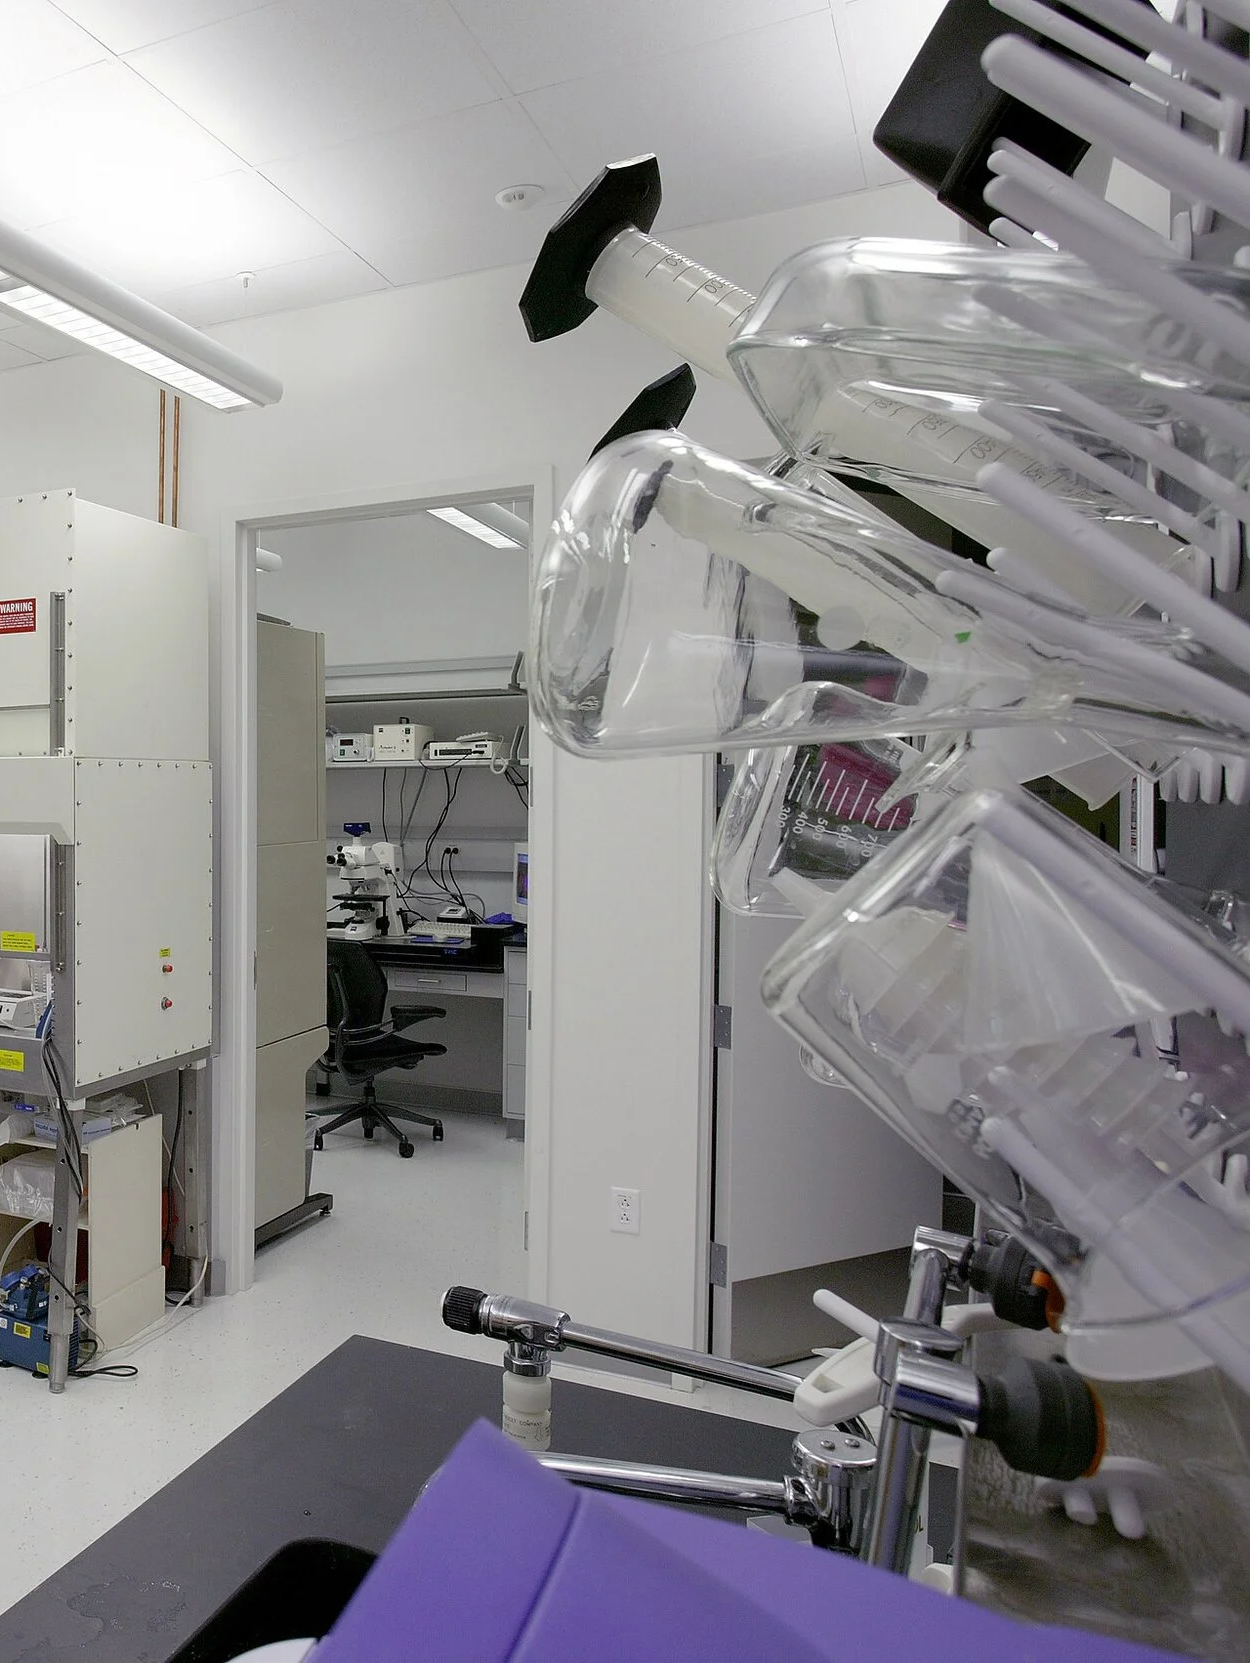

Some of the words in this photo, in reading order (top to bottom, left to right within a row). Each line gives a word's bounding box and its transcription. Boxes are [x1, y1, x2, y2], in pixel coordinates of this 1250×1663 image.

[0, 601, 33, 614] WARNING
[778, 806, 791, 829] 300
[793, 812, 808, 834] 400
[812, 817, 829, 841] 500
[835, 824, 852, 849] 600
[861, 833, 878, 858] 700
